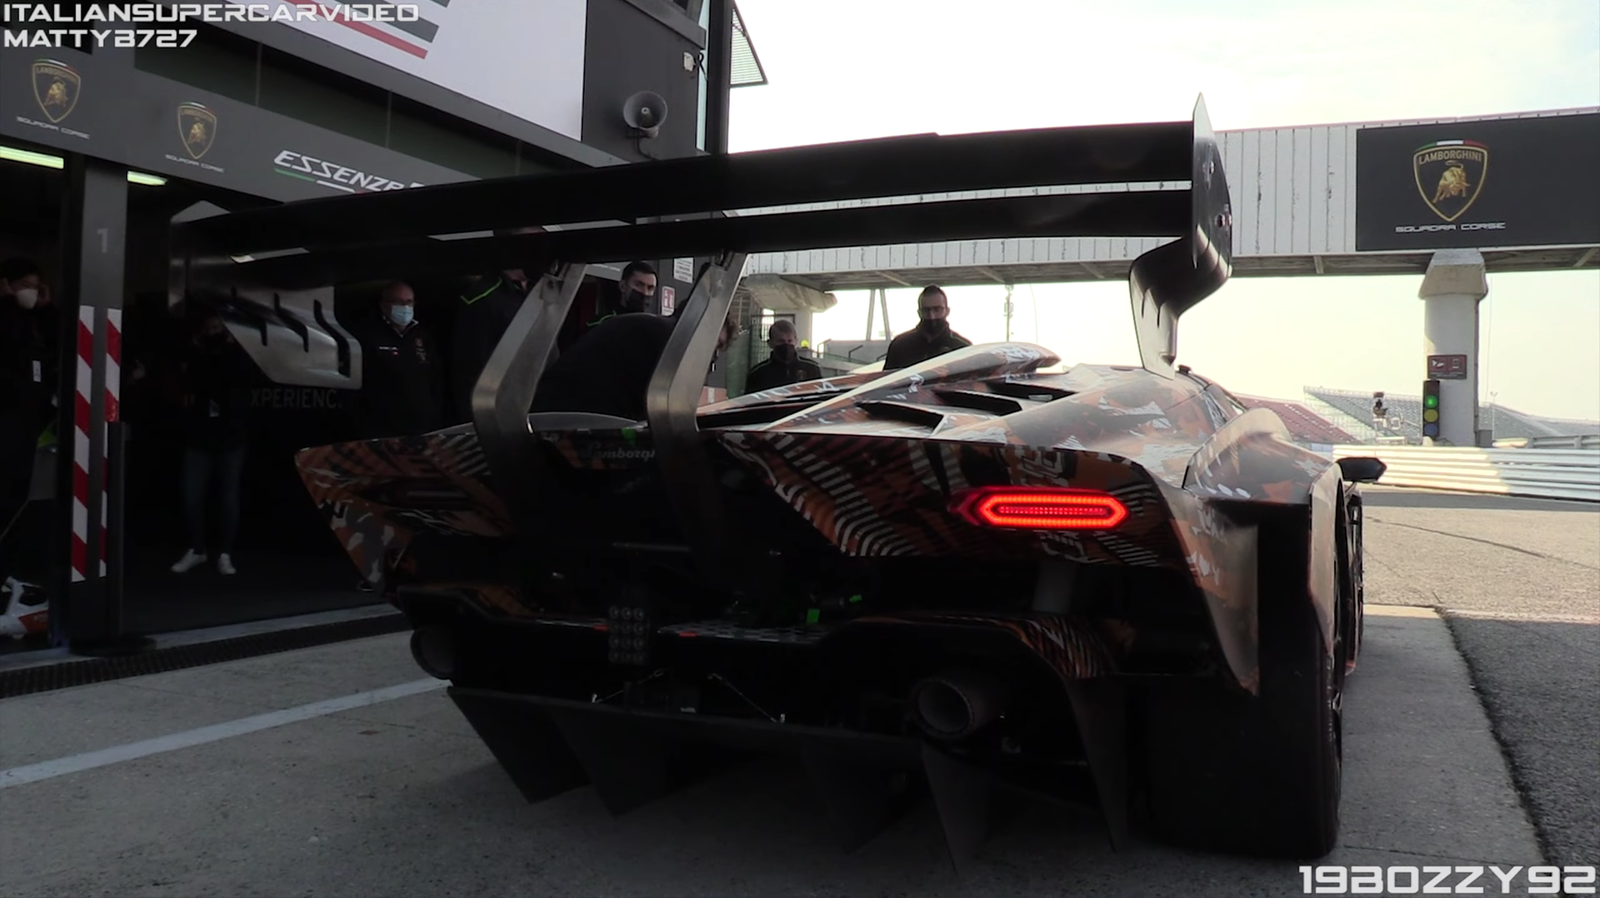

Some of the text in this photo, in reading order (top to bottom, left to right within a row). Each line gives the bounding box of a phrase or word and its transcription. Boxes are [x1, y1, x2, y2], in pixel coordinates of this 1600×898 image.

[1418, 150, 1482, 165] LAMBORGHINI
[1395, 222, 1505, 233] SQUADRA CORSE
[97, 228, 109, 253] 1
